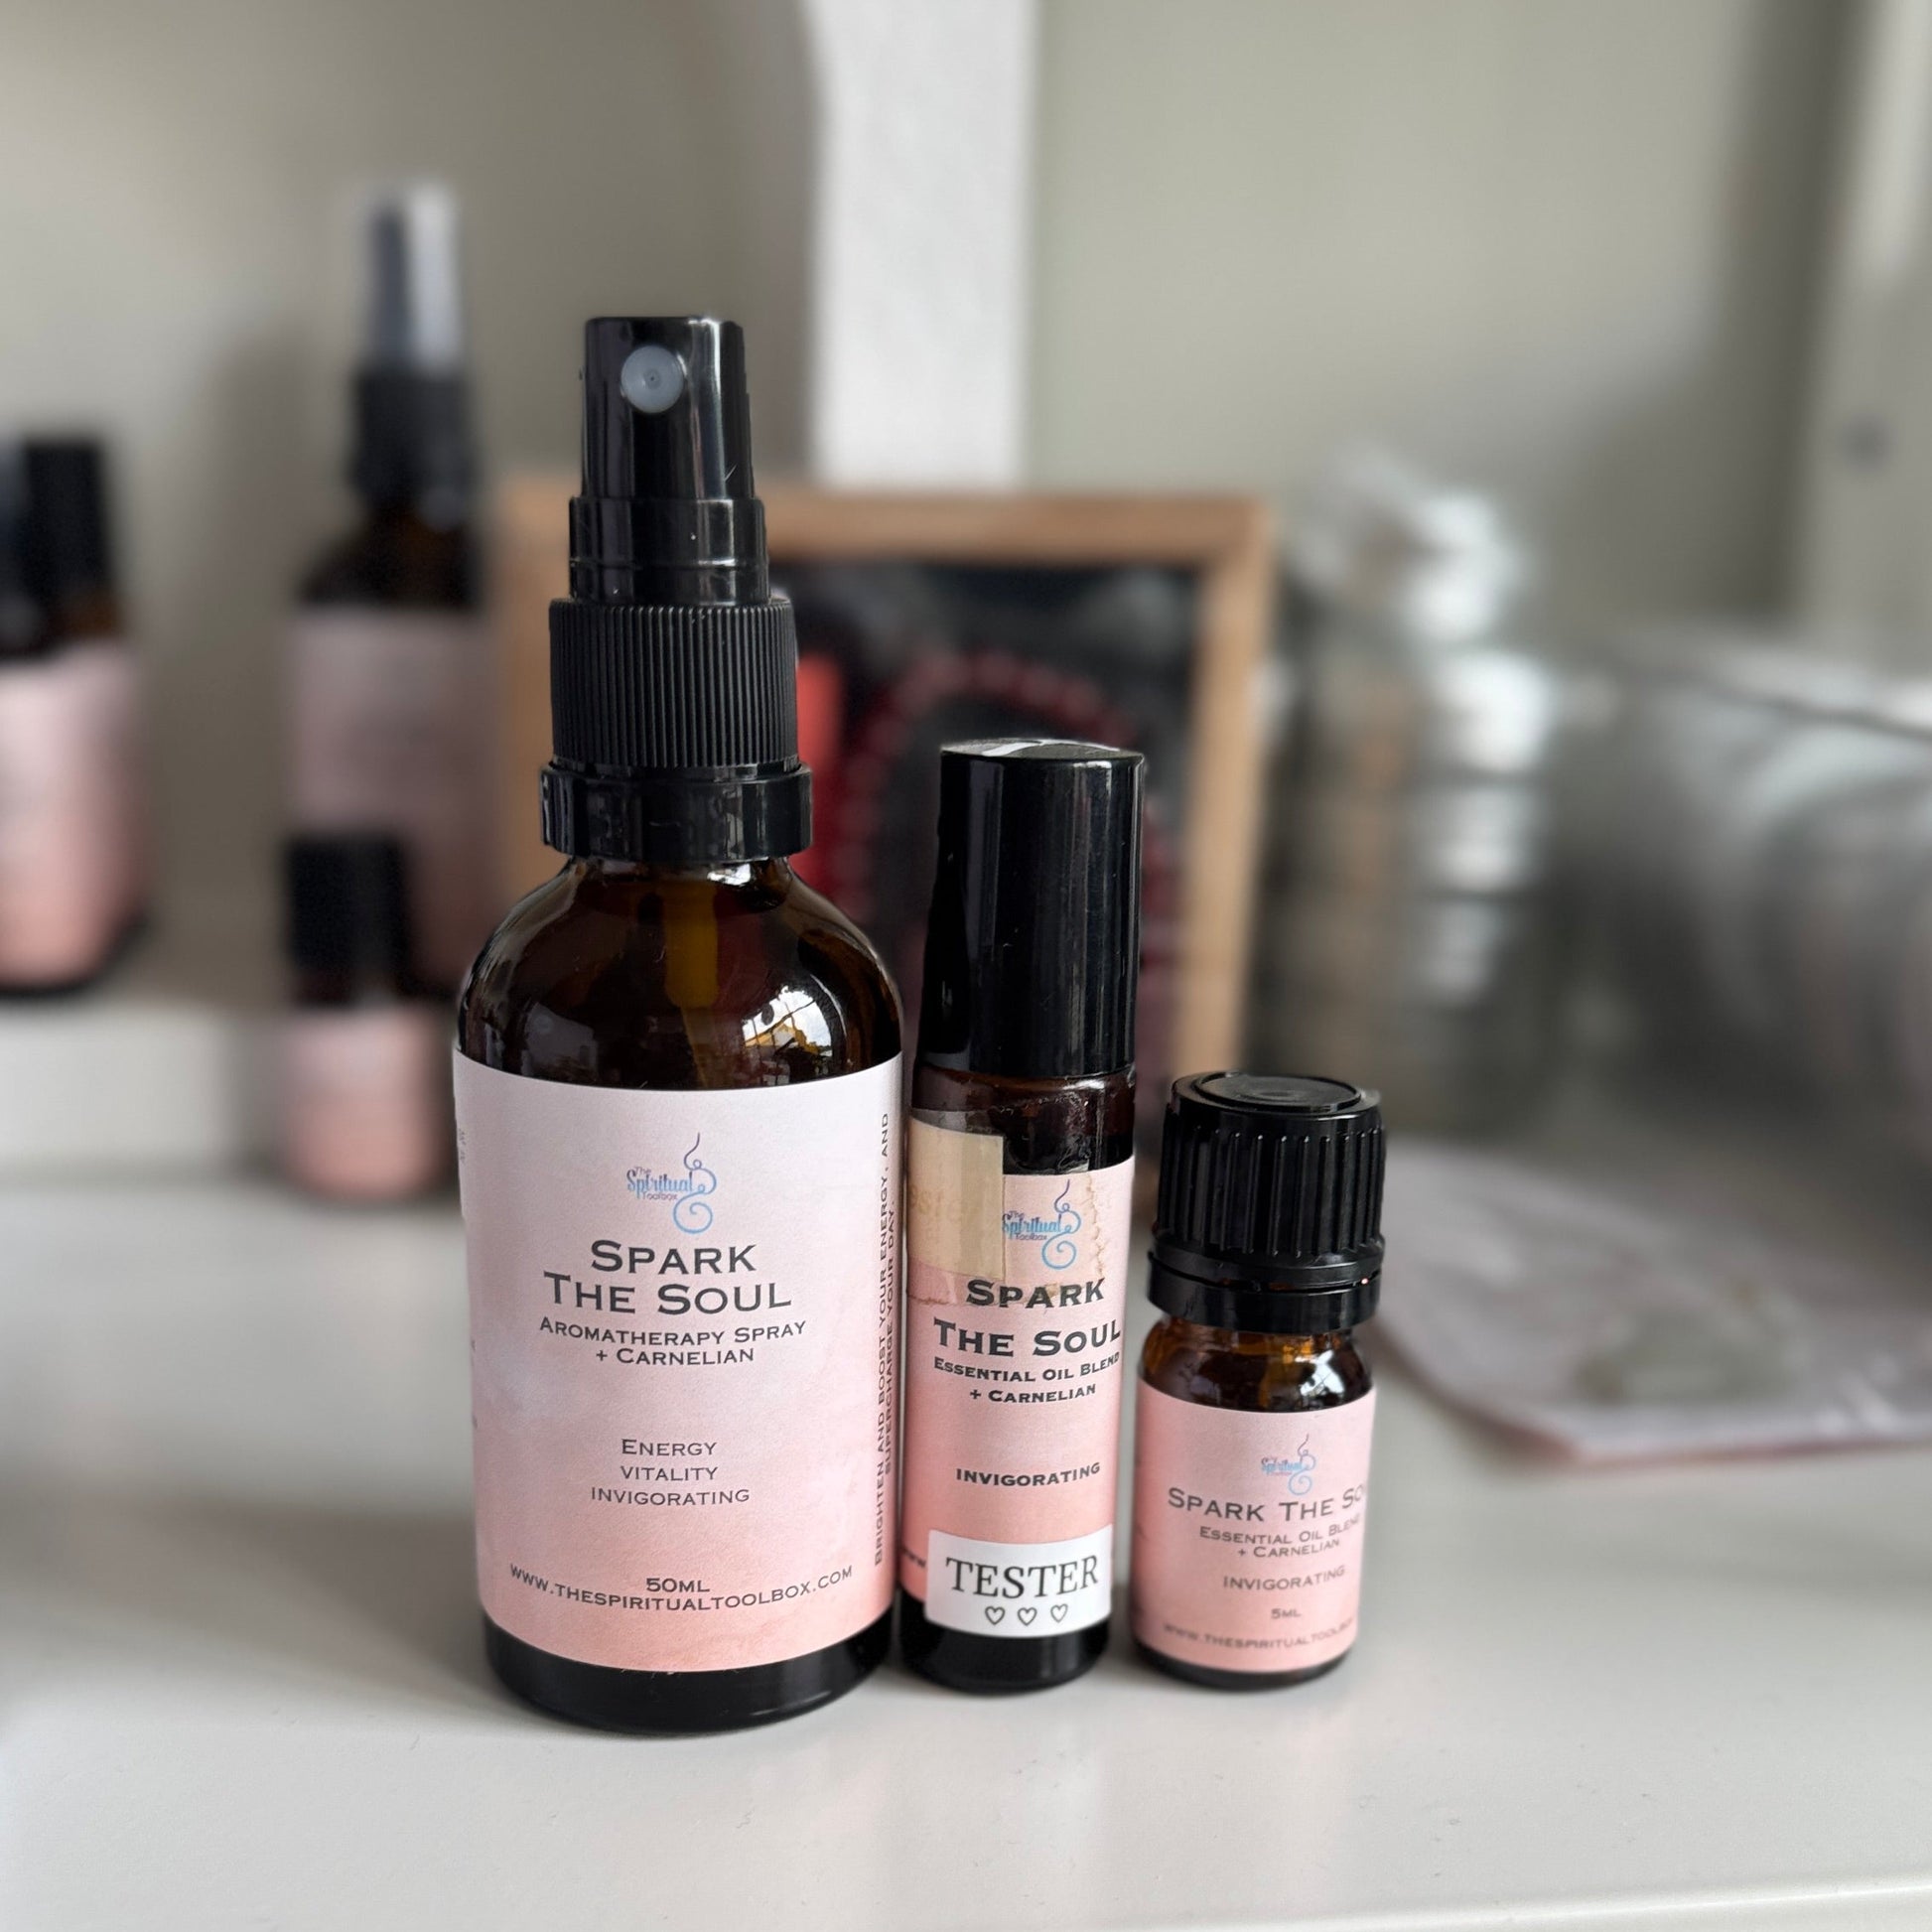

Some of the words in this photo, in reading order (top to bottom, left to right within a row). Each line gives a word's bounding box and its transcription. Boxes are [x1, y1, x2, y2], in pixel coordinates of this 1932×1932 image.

[626, 1169, 693, 1199] Spiritual
[591, 1239, 758, 1276] SPARK
[543, 1271, 636, 1315] THE
[657, 1283, 792, 1316] SOUL
[966, 1278, 1105, 1310] SPARK
[539, 1316, 726, 1347] AROMATHERAPY
[734, 1320, 806, 1344] SPRAY
[933, 1316, 1015, 1357] THE
[1033, 1319, 1122, 1356] SOUL
[596, 1350, 608, 1362] +
[616, 1347, 756, 1367] CARNELIAN
[934, 1357, 1036, 1382] ESSENTIAL
[1042, 1368, 1074, 1382] OIL
[1080, 1352, 1120, 1377] BLEND
[970, 1390, 982, 1400] +
[988, 1384, 1096, 1404] CARNELIAN
[621, 1439, 717, 1457] ENERGY
[620, 1465, 718, 1482] VITALITY
[956, 1462, 1101, 1486] INVIGORATING
[591, 1487, 751, 1507] INVIGORATING
[1168, 1487, 1265, 1521] SPARK
[1279, 1498, 1334, 1521] THE
[875, 1461, 885, 1566] BRIGHTEN
[1199, 1526, 1292, 1545] ESSENTIAL
[1299, 1530, 1322, 1543] OIL
[1253, 1538, 1339, 1558] CARNELIAN
[510, 1564, 853, 1611] WWW.THESPIRITUALTOOLBOX.COM
[645, 1578, 711, 1594] 50ML
[945, 1555, 1098, 1599] TESTER
[1223, 1566, 1345, 1590] INVIGORATING
[1271, 1608, 1301, 1620] 5ML
